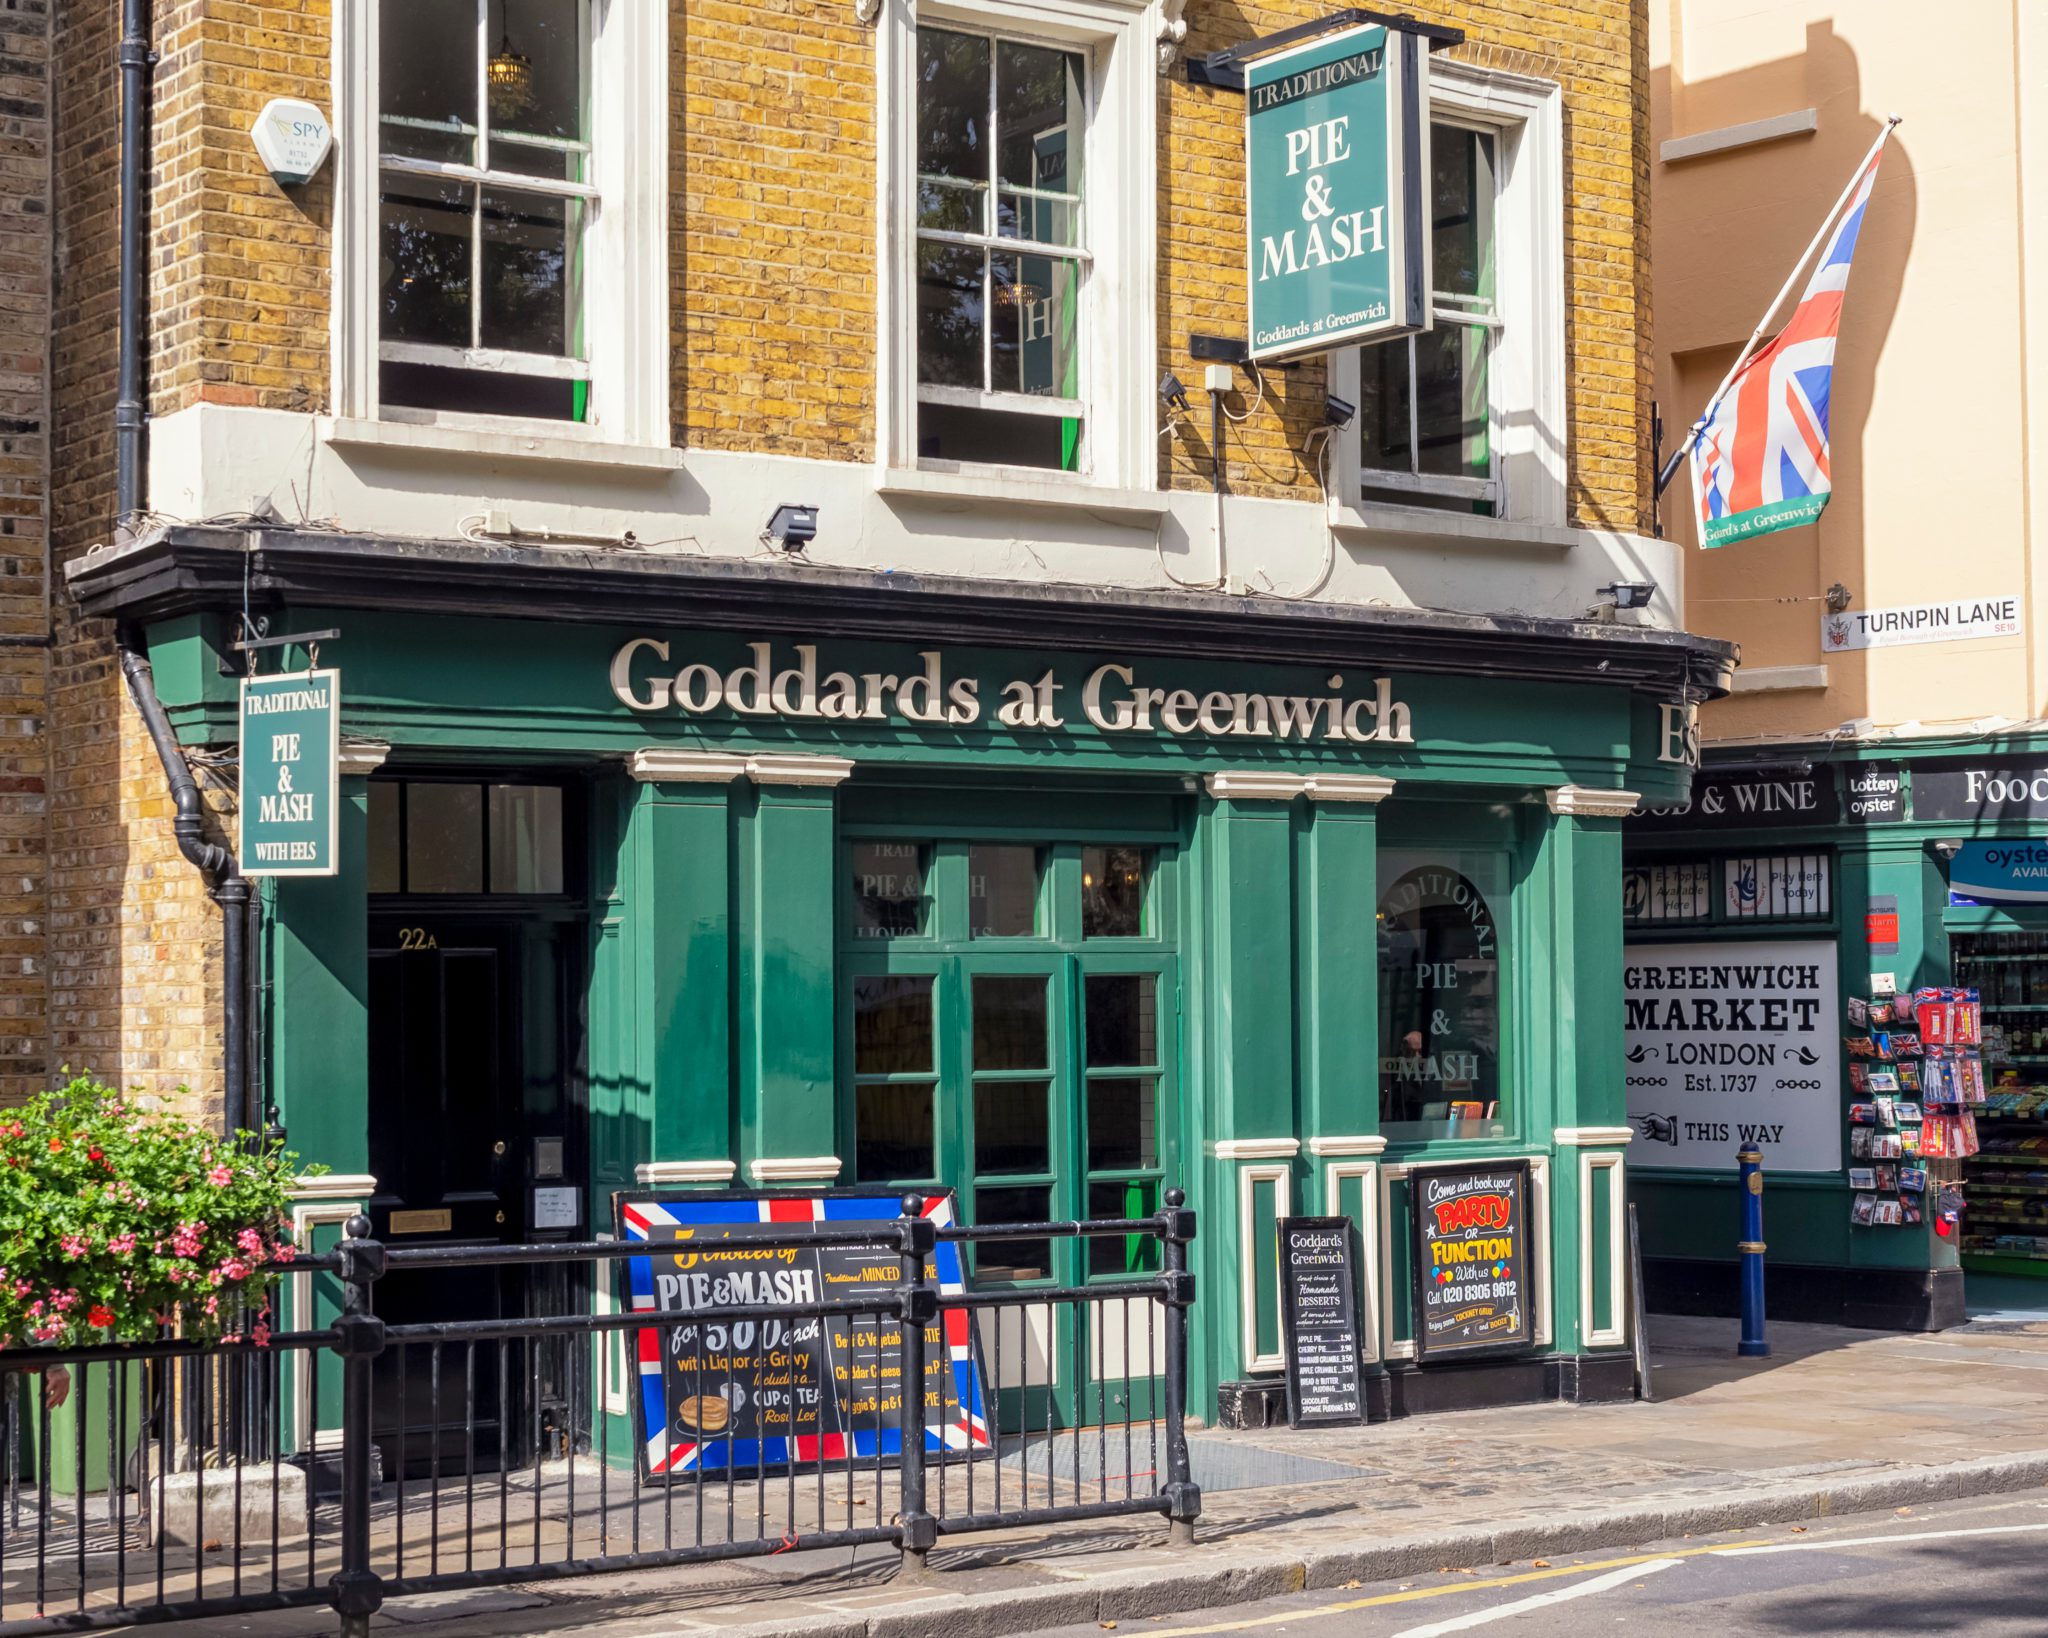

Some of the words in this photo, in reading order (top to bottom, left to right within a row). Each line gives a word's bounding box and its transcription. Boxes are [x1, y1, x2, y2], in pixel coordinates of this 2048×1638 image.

[1254, 50, 1383, 110] TRADITIONAL
[293, 121, 323, 139] SPY
[1285, 115, 1351, 177] PIE
[1301, 173, 1336, 222] &
[1259, 205, 1386, 282] MASH
[1256, 322, 1310, 346] Goddards
[1312, 319, 1324, 333] at
[1326, 302, 1387, 329] Greenwich
[1740, 519, 1752, 533] at
[1856, 607, 1950, 634] TURNPIN
[1957, 600, 2016, 624] LANE
[1994, 623, 2016, 633] SE10
[609, 637, 981, 724] Goddards
[997, 668, 1064, 728] at
[1081, 662, 1415, 744] Greenwich
[246, 689, 329, 716] TRADITIONAL
[272, 733, 301, 763] PIE
[277, 764, 294, 794] &
[1850, 777, 1899, 794] Lottery
[1701, 785, 1727, 815] &
[1731, 780, 1818, 813] WINE
[1851, 798, 1896, 816] oyster
[259, 793, 314, 824] MASH
[256, 842, 289, 862] WITH
[290, 841, 317, 861] EELS
[862, 874, 899, 898] PIE
[902, 874, 916, 898] &
[1771, 872, 1796, 885] Play
[1798, 871, 1824, 882] Here
[1781, 887, 1815, 900] Today
[1379, 873, 1495, 960] TRADITIONAL
[399, 927, 438, 950] 22A
[1415, 963, 1458, 989] PIE
[1624, 965, 1820, 991] GREENWICH
[1430, 1008, 1453, 1036] &
[1624, 998, 1820, 1032] MARKET
[1665, 1042, 1776, 1066] LONDON
[1395, 1054, 1480, 1082] MASH
[1684, 1073, 1717, 1092] Est.
[1720, 1074, 1757, 1093] 1737
[1684, 1122, 1730, 1142] THIS
[1736, 1123, 1784, 1143] WAY
[1427, 1179, 1457, 1202] Come
[1457, 1176, 1473, 1192] and
[1473, 1175, 1494, 1189] book
[1493, 1178, 1513, 1193] your
[1434, 1194, 1511, 1235] PARTY
[1290, 1233, 1343, 1248] Goddard's
[1464, 1227, 1479, 1239] OR
[1291, 1251, 1344, 1265] Greenwich
[1312, 1246, 1321, 1254] at
[1430, 1237, 1513, 1266] FUNCTION
[825, 1272, 862, 1285] Traditional
[861, 1265, 901, 1283] MINCED
[1329, 1273, 1337, 1283] of
[1455, 1264, 1478, 1281] With
[1478, 1268, 1489, 1278] us
[1299, 1283, 1340, 1296] Homemade
[1443, 1286, 1463, 1304] 020
[1464, 1283, 1491, 1301] 8305
[1492, 1280, 1517, 1298] 9612
[1298, 1296, 1341, 1307] DESSERTS
[1428, 1321, 1443, 1331] Enjoy
[1442, 1317, 1456, 1328] some
[1478, 1321, 1489, 1331] and
[857, 1332, 866, 1347] &
[1297, 1335, 1314, 1344] APPLE
[1313, 1334, 1322, 1343] PIE
[1297, 1345, 1318, 1353] CHERRY
[1317, 1345, 1327, 1353] PIE
[753, 1357, 766, 1369] o
[1341, 1354, 1354, 1363] 3.50
[836, 1364, 869, 1380] Chddar
[1299, 1366, 1315, 1375] APPLE
[1314, 1365, 1338, 1374] CRUMBLE
[1342, 1364, 1354, 1373] 3.50
[1300, 1377, 1315, 1386] BREAD
[1320, 1376, 1340, 1385] BUTTER
[1312, 1385, 1336, 1394] PUDDING
[1342, 1382, 1355, 1392] 3.50
[753, 1389, 780, 1407] CUP
[796, 1387, 823, 1405] TEA
[840, 1397, 868, 1415] Vggie
[889, 1394, 897, 1409] &
[1301, 1396, 1330, 1405] CHOCOLATE
[1302, 1404, 1322, 1414] SPONGE
[1322, 1403, 1344, 1412] PUDDING
